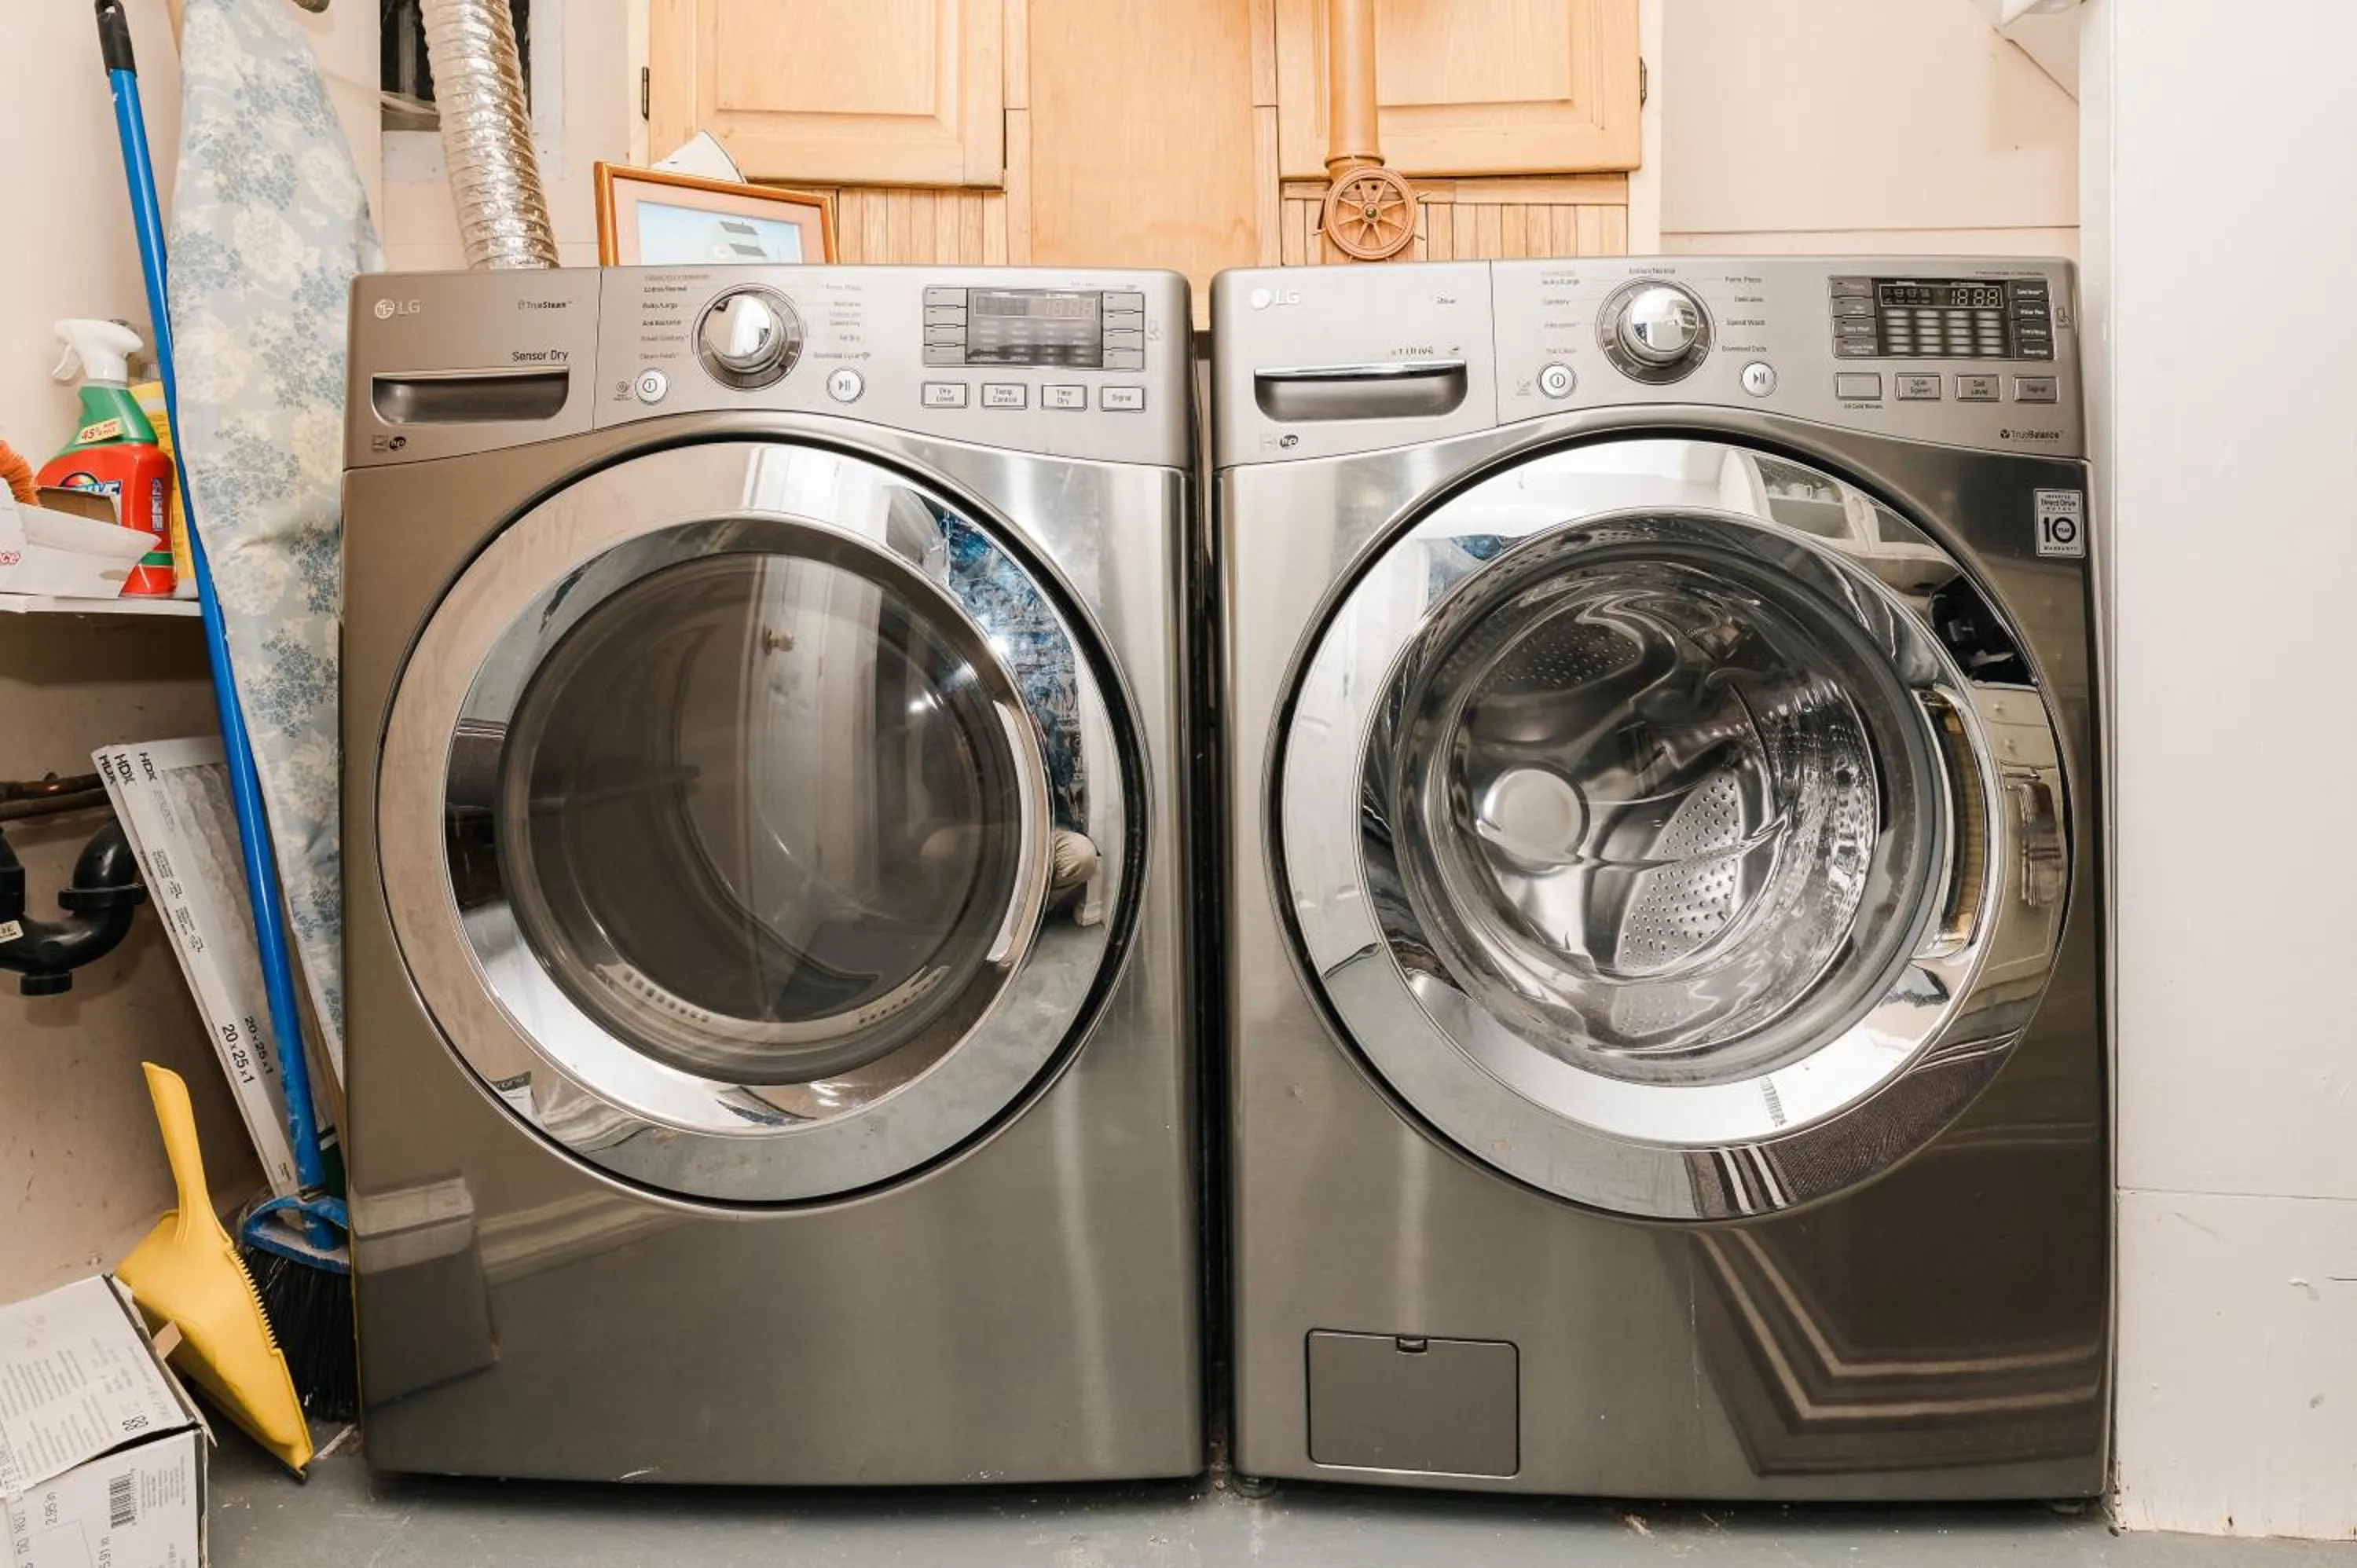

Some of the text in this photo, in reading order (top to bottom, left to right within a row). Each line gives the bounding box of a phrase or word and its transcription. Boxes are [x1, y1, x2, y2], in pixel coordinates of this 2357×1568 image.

[1275, 288, 1300, 305] LG
[397, 300, 420, 316] LG
[511, 350, 570, 361] Sensor Dry
[2044, 517, 2077, 544] 10
[114, 753, 136, 786] HDX
[139, 752, 158, 782] HDX
[244, 1016, 258, 1034] 20
[222, 1024, 238, 1042] 20
[232, 1050, 249, 1068] 25
[243, 1075, 255, 1083] 1
